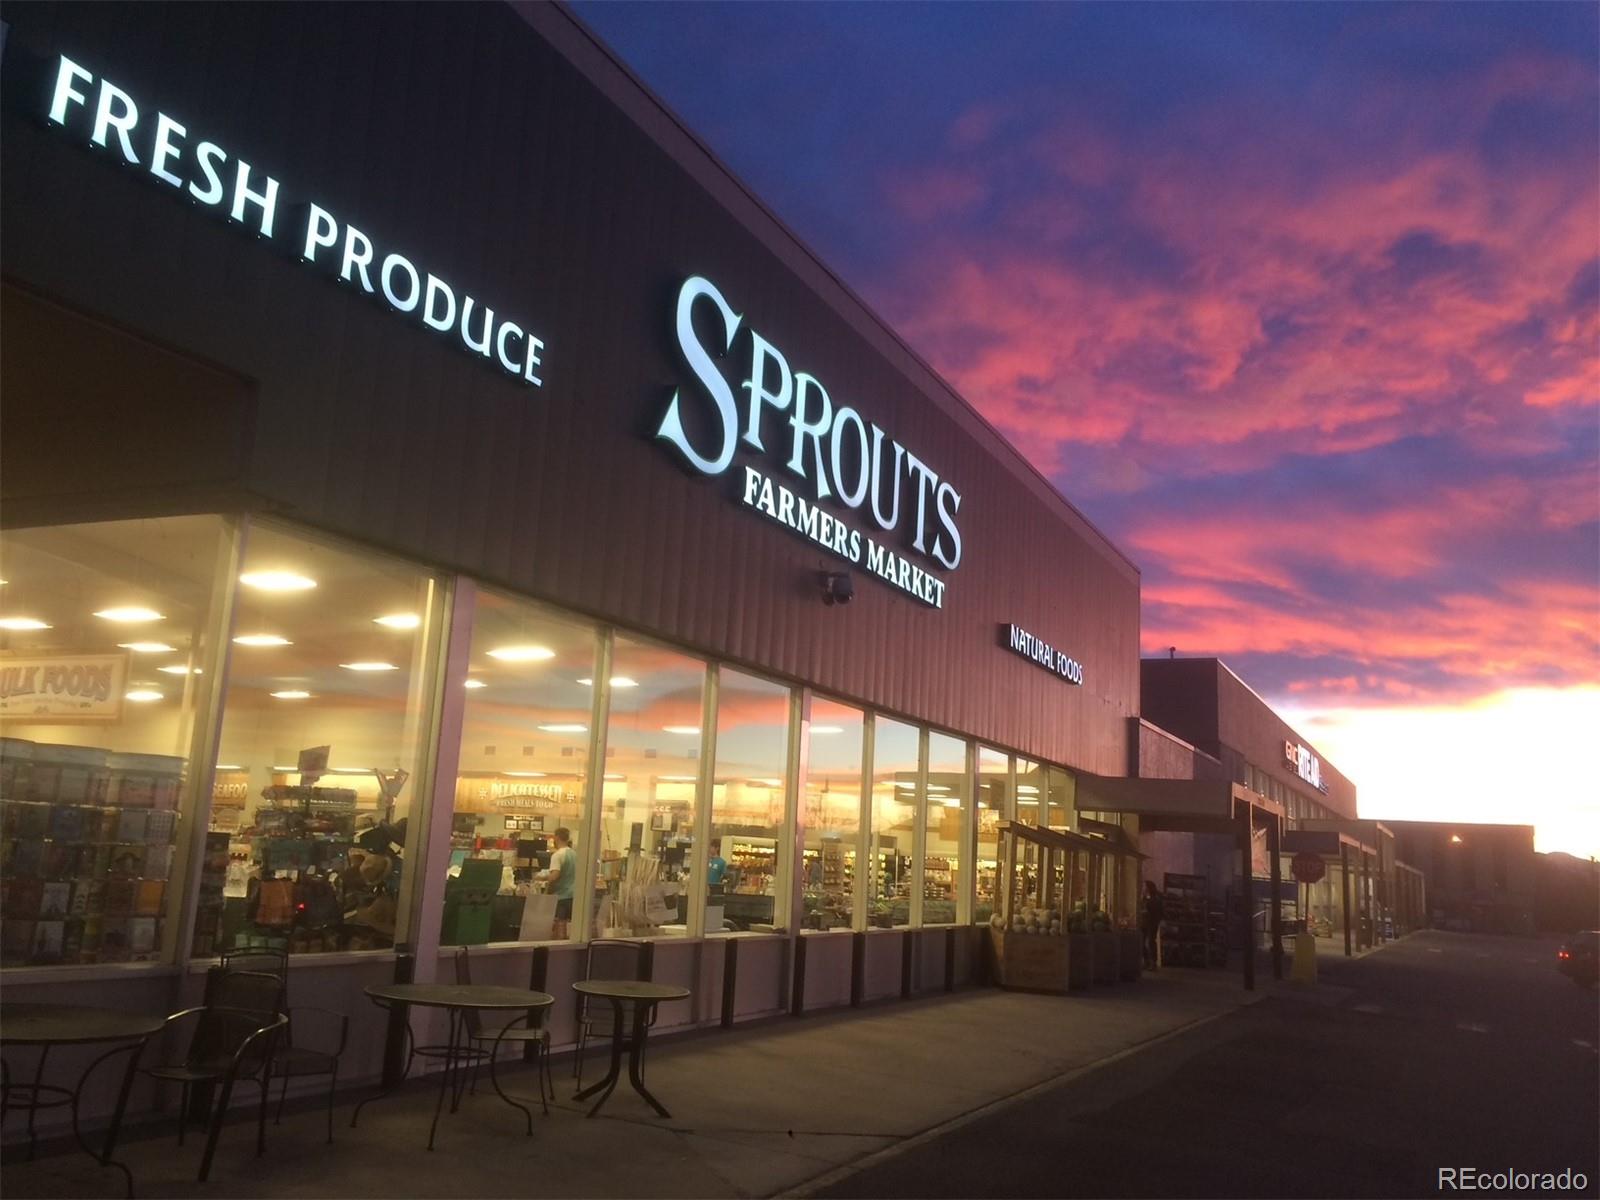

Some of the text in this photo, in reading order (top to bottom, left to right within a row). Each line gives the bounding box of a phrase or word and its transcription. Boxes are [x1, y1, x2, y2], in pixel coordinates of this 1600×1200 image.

[49, 54, 544, 387] FRESH PRODUCE
[656, 276, 962, 570] SPROUTS
[743, 466, 945, 609] FARMERS MARKET
[0, 664, 112, 702] ULK FOODS
[1010, 623, 1083, 685] NATURAL FOODS
[212, 782, 248, 798] SEAFOO
